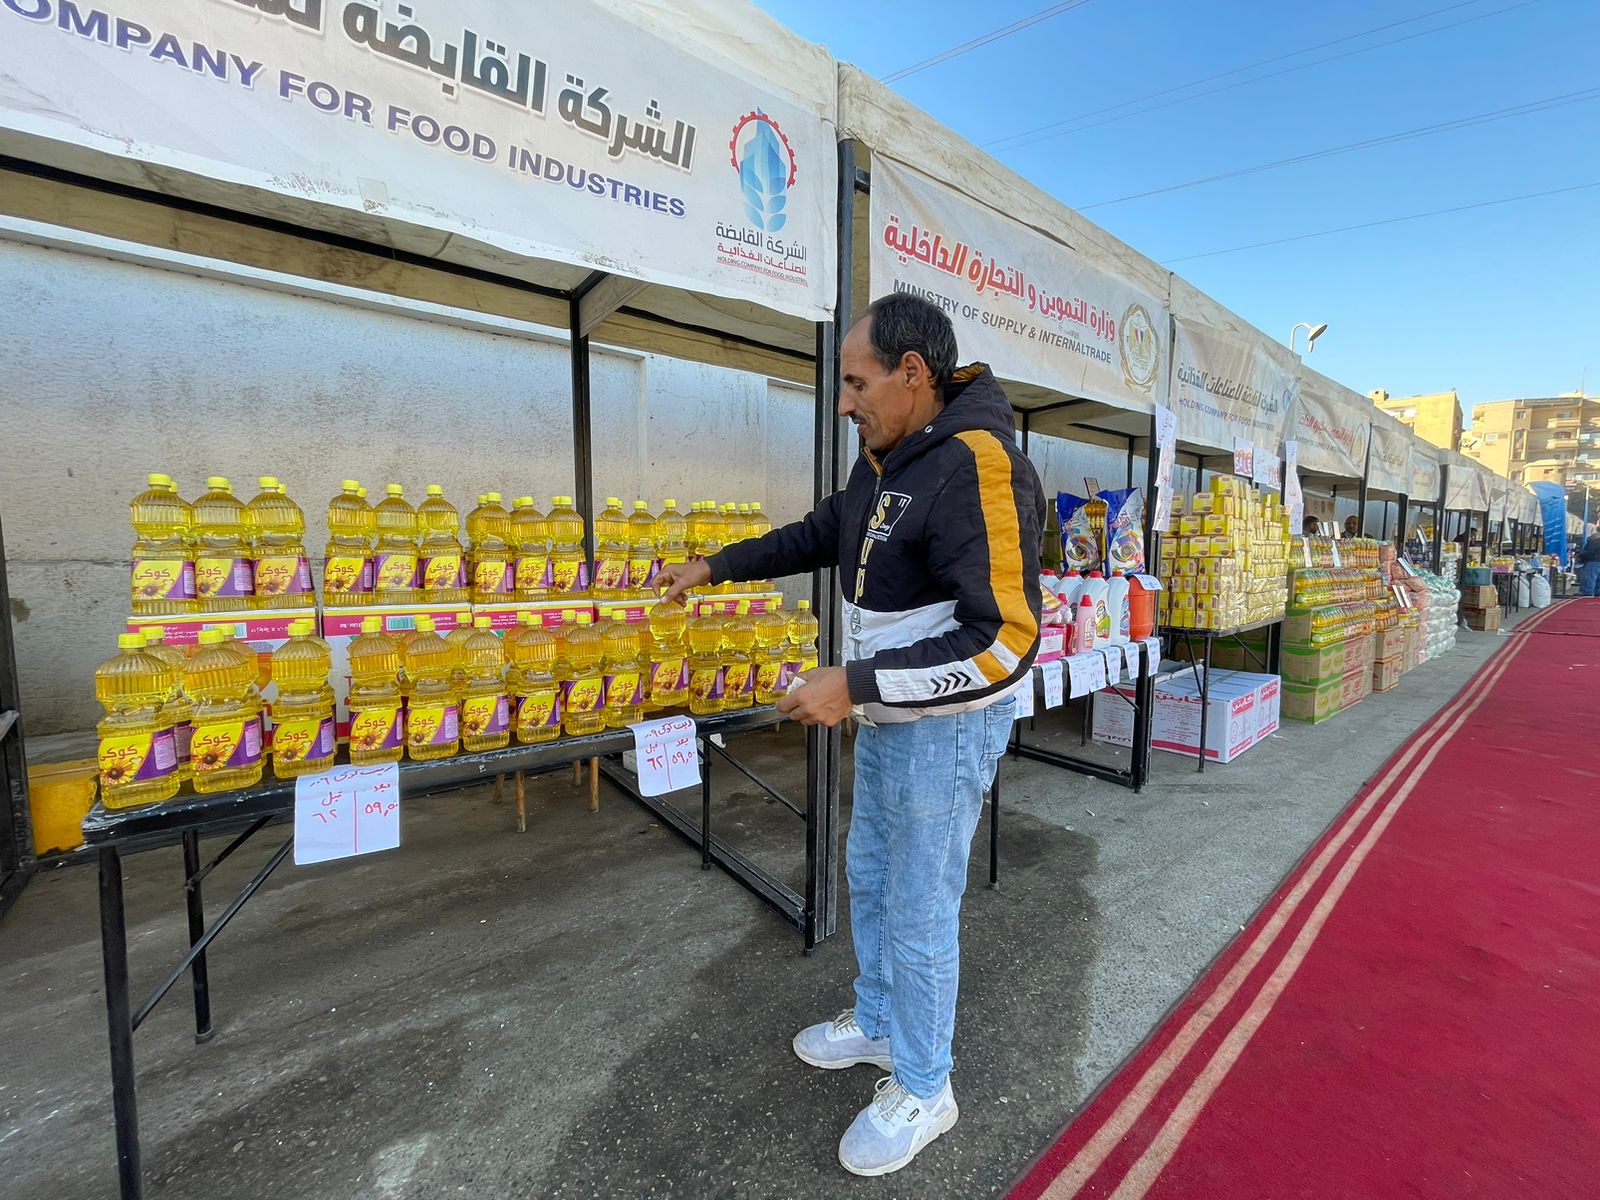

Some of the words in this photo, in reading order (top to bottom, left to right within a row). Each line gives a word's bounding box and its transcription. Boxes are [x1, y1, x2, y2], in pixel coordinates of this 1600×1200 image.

[558, 74, 696, 170] الشركة
[279, 70, 371, 124] FOR
[387, 104, 496, 161] FOOD
[508, 145, 685, 217] INDUSTRIES
[715, 221, 762, 247] القابضة
[766, 236, 807, 261] الشركة
[884, 215, 968, 277] الداخلية
[967, 250, 1024, 297] التجارة
[1027, 283, 1037, 310] و
[1039, 290, 1088, 324] التموين
[962, 304, 979, 325] OF
[981, 312, 1029, 336] SUPPLY
[1028, 326, 1037, 339] &
[1089, 305, 1116, 343] وزارة
[135, 567, 171, 580] كوكى
[257, 565, 289, 578] كوكى
[327, 564, 355, 575] كوكى
[385, 561, 411, 571] كوكى
[428, 562, 455, 573] كوكى
[477, 568, 499, 578] كوكى
[573, 685, 597, 698] كوكى
[463, 704, 489, 717] كوكى
[523, 701, 548, 713] كوكى
[355, 716, 387, 731] كوكى
[193, 732, 231, 749] كوكى
[275, 729, 309, 744] كوكى
[100, 744, 138, 762] كوكى
[646, 755, 663, 770] ٦٢
[312, 809, 338, 824] ٦٢
